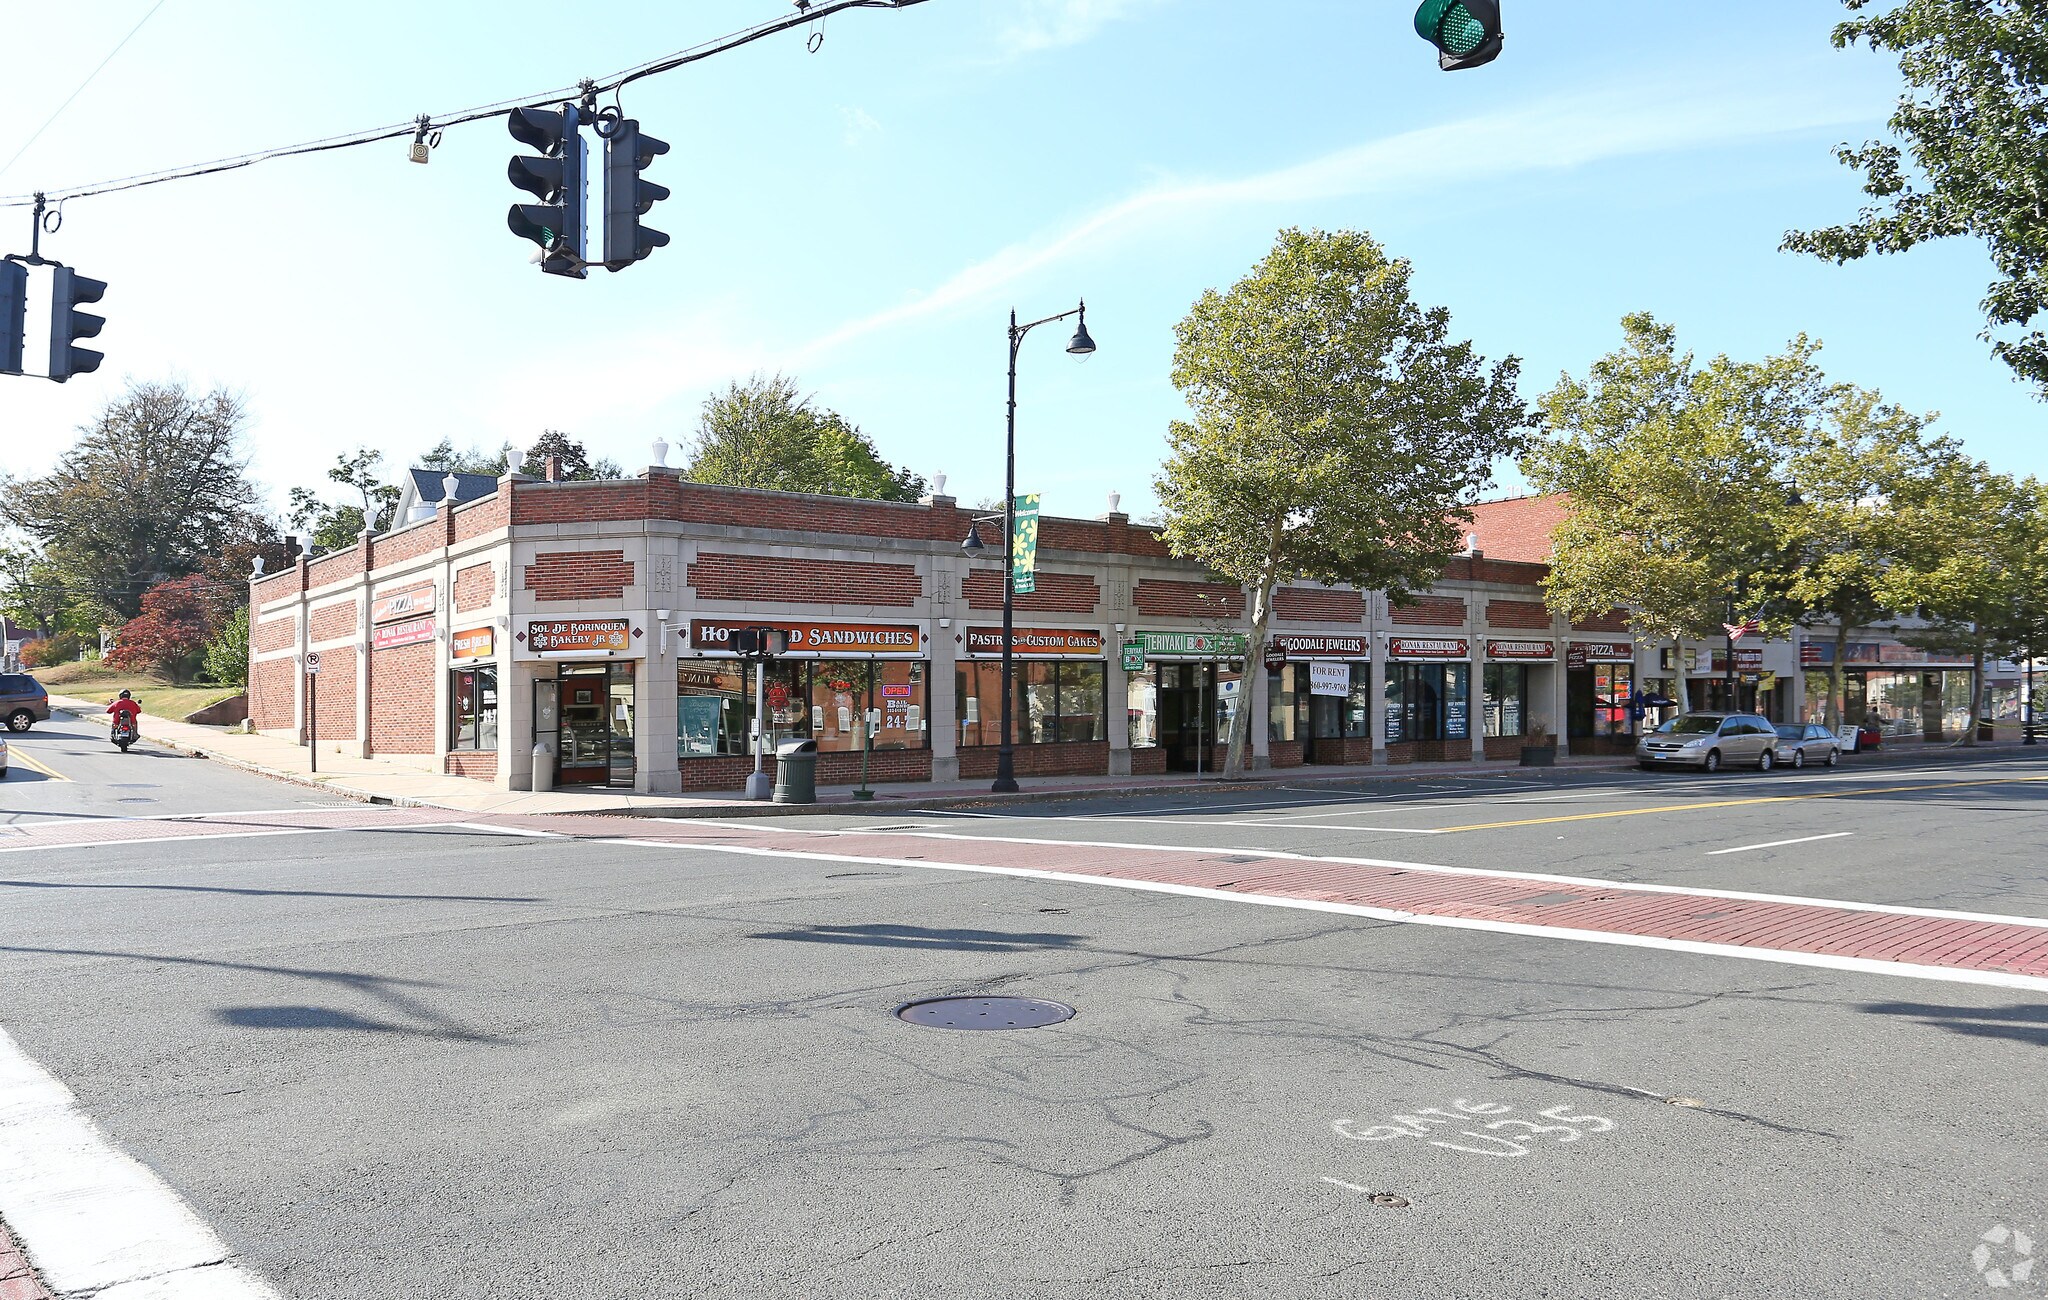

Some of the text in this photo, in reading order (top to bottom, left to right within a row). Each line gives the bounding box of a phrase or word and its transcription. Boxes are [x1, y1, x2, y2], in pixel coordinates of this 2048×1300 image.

[1015, 509, 1038, 517] Welcome
[389, 594, 414, 615] PIZZA
[530, 622, 626, 635] SOL DE BORINQUEN
[550, 635, 606, 648] BAKERY JR
[701, 626, 740, 642] HO
[808, 628, 913, 646] SANDWICHES
[969, 633, 1018, 646] PASTRS
[1026, 634, 1064, 646] CUSTOM
[1067, 635, 1098, 647] CAKES
[454, 638, 471, 651] FRESH
[1148, 634, 1184, 651] TERIYAKI
[1187, 635, 1214, 652] BOX
[1287, 637, 1361, 652] GOODALE JEWELERS
[1591, 644, 1614, 656] PIZZA
[1312, 666, 1346, 677] FOR RENT
[884, 687, 908, 695] OPEN
